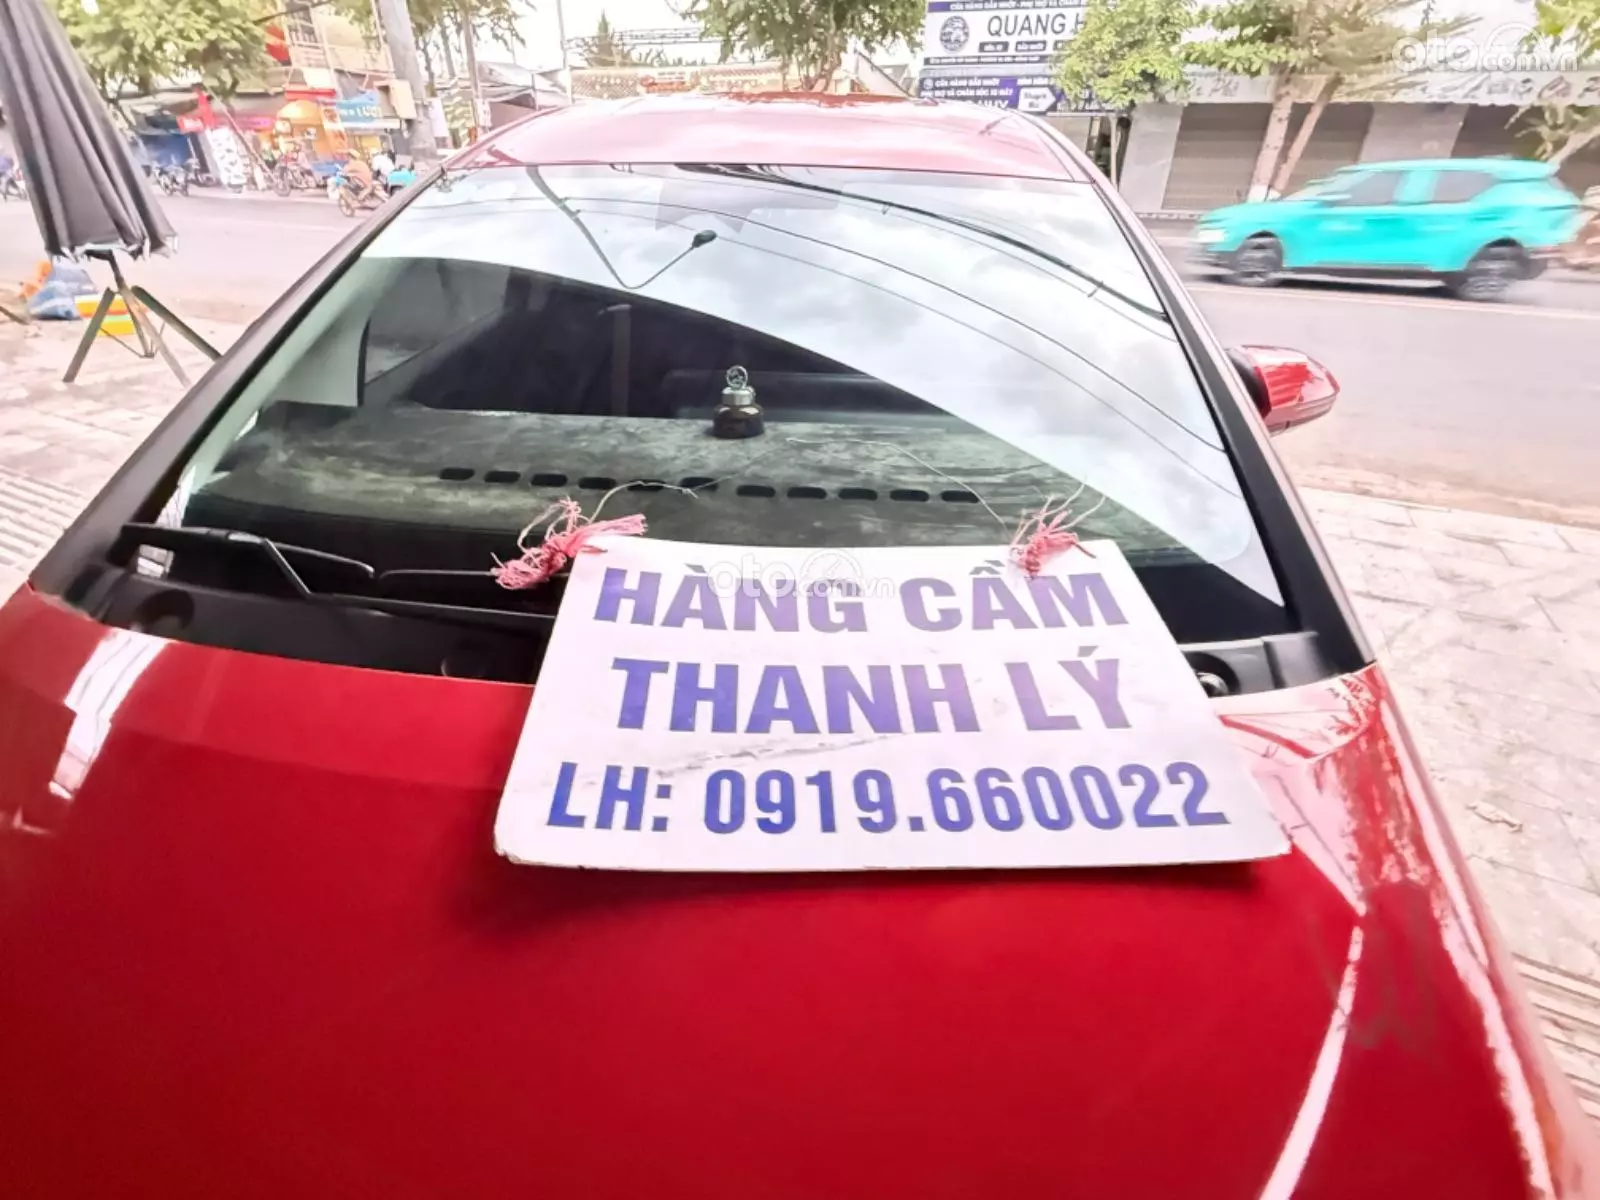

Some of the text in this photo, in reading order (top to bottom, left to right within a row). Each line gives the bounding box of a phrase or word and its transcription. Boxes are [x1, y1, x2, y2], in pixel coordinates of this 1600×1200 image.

[987, 12, 1066, 37] QUANG
[593, 560, 1129, 632] HÀNG CẦM
[611, 645, 1132, 734] THANH LÝ
[546, 761, 1230, 834] LH: 0919.660022
